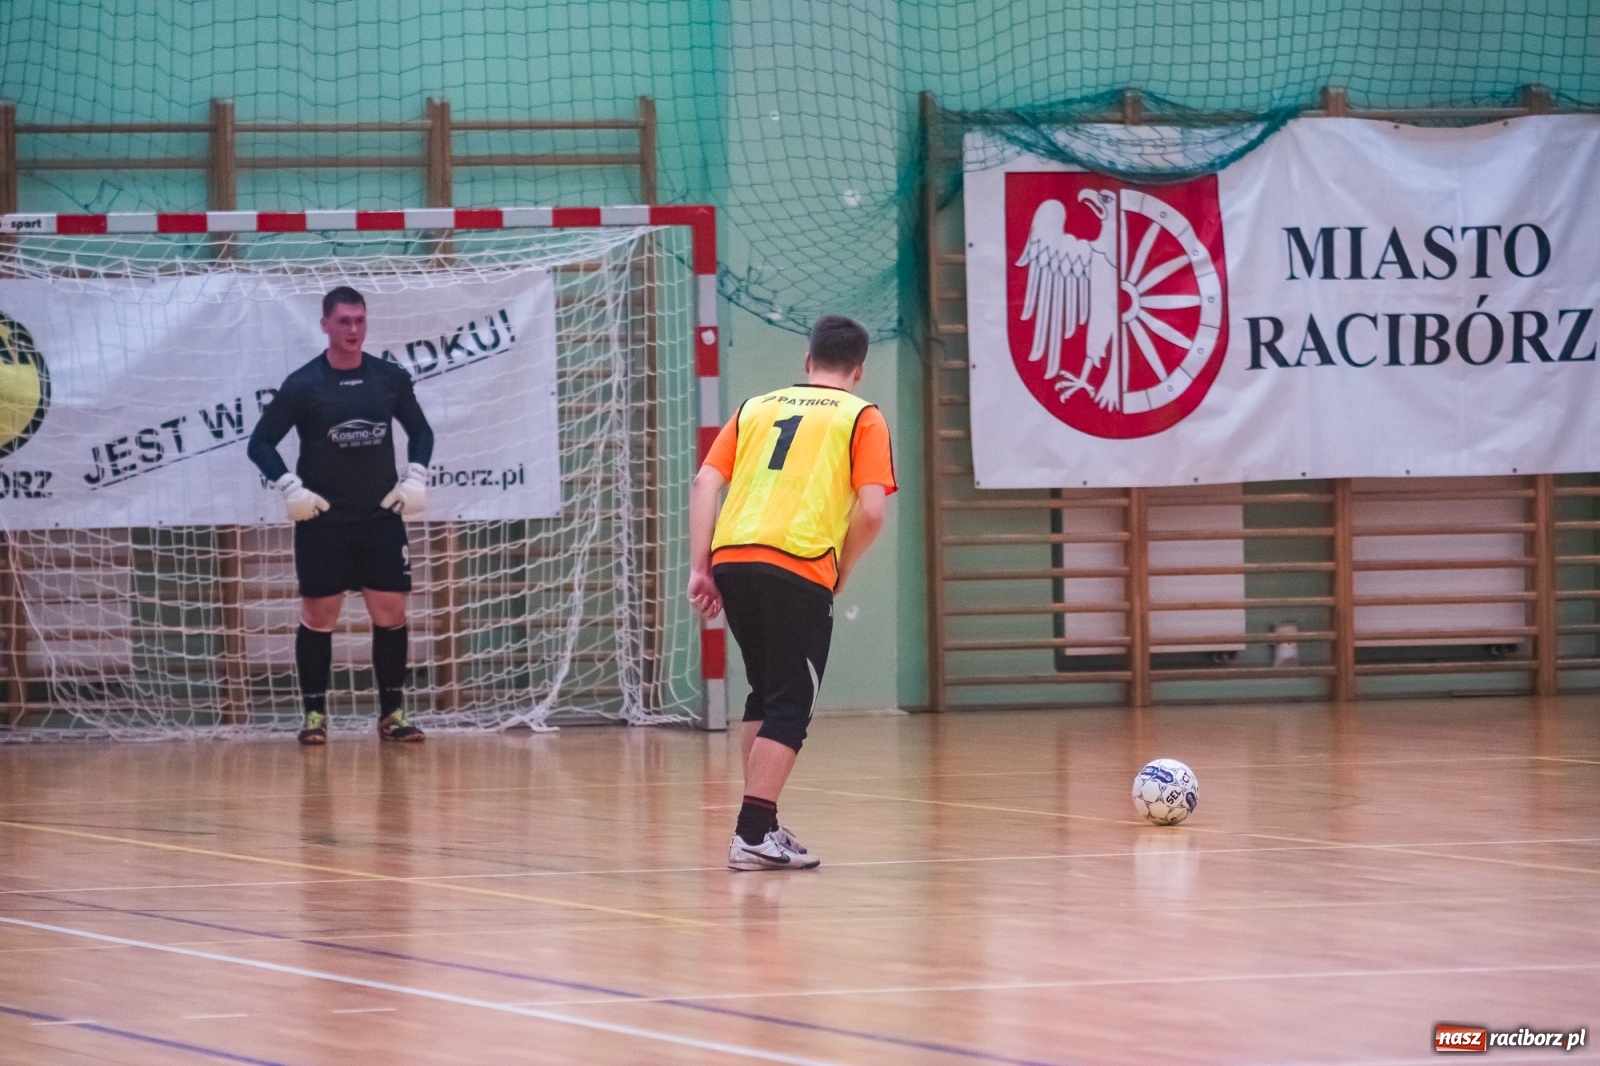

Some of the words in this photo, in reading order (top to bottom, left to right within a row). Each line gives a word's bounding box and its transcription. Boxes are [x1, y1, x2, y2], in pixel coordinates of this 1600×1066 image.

[10, 219, 42, 231] sport
[1281, 223, 1551, 281] MIASTO
[1243, 294, 1598, 370] RACIBÓRZ
[777, 395, 841, 408] PATRICK
[84, 416, 188, 485] JEST
[198, 397, 245, 440] W
[767, 414, 804, 471] 1
